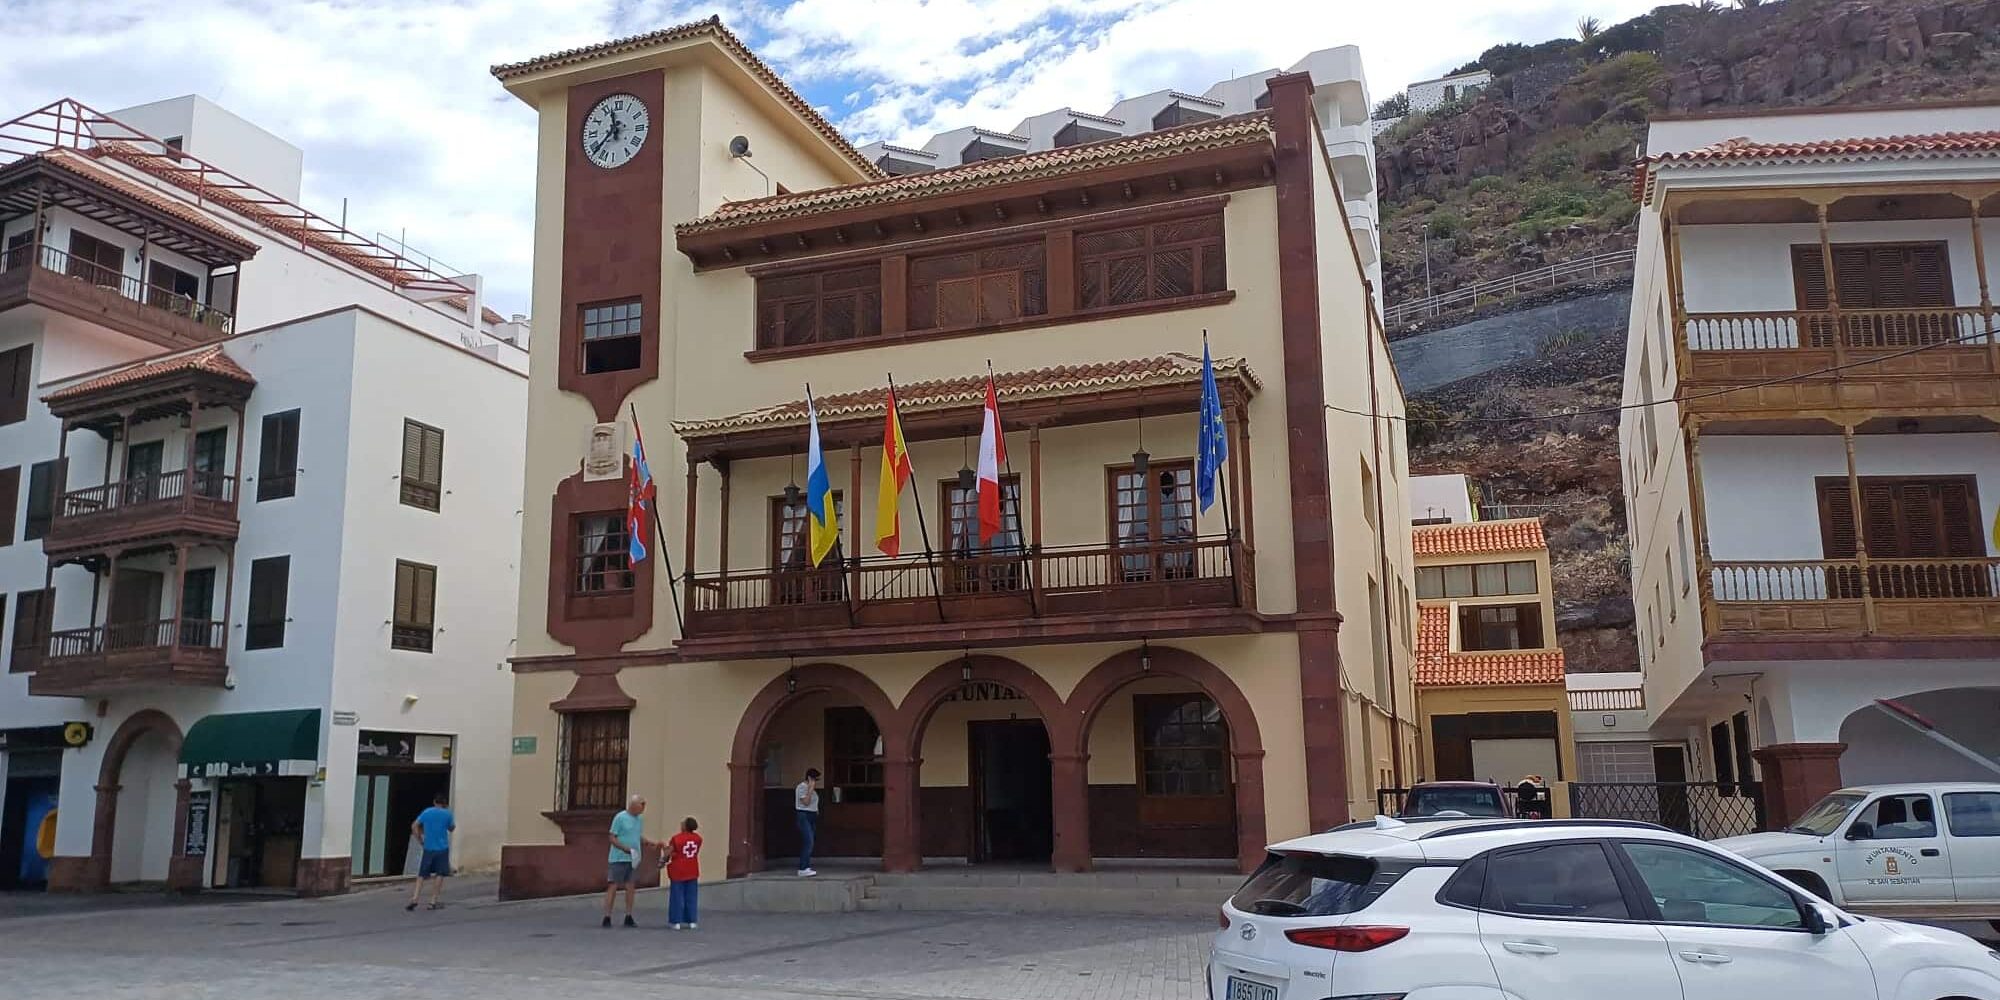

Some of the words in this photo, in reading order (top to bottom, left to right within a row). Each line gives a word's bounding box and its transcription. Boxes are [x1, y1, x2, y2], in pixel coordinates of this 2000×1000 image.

[205, 762, 229, 777] BAR
[1865, 847, 1918, 865] AYUNTAMIENTO
[1233, 981, 1253, 1000] 1855
